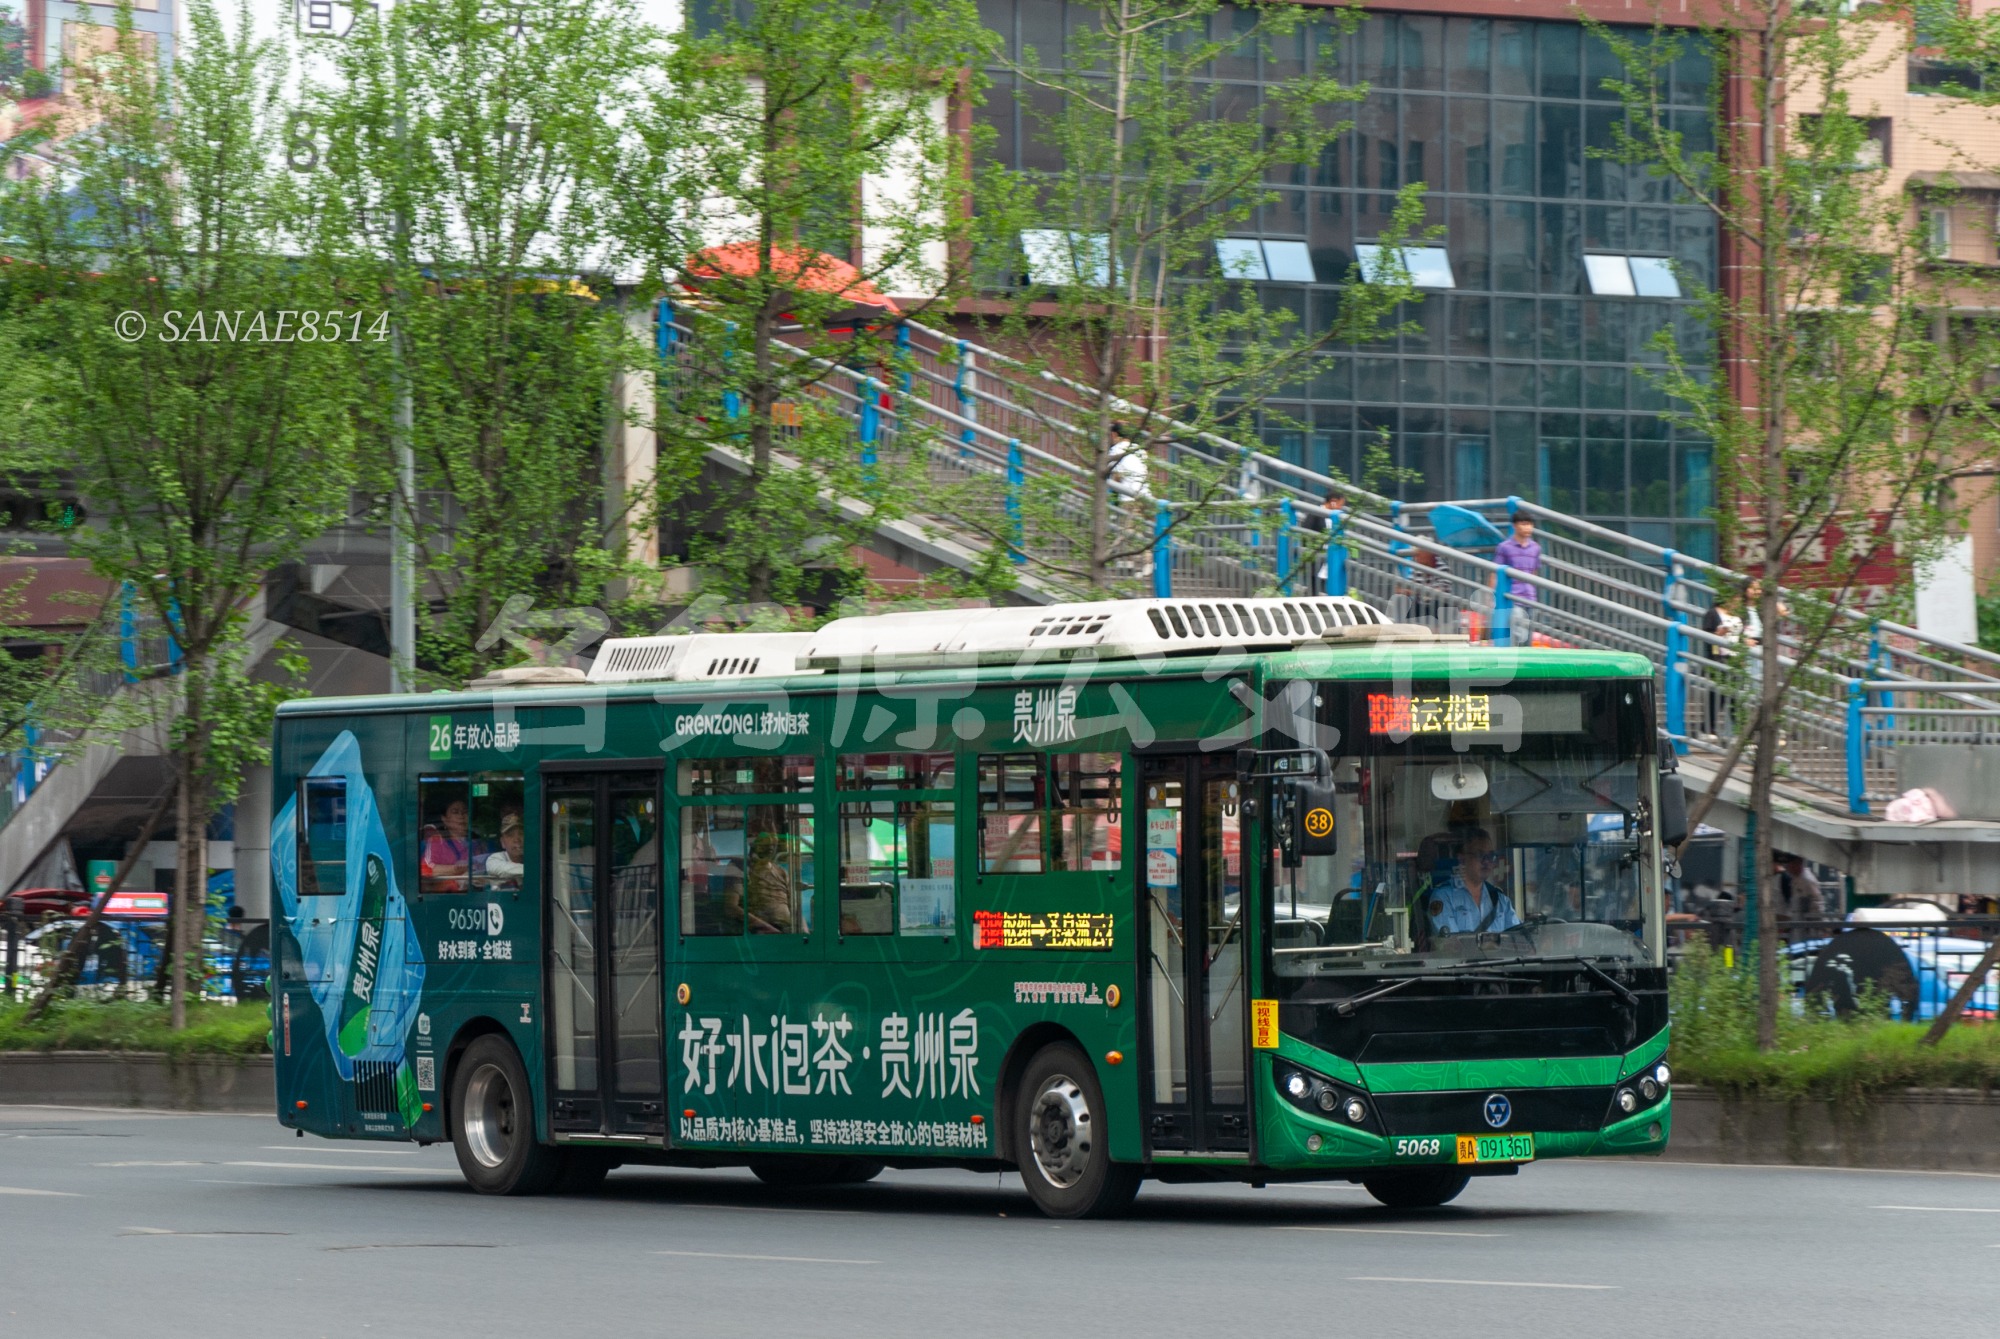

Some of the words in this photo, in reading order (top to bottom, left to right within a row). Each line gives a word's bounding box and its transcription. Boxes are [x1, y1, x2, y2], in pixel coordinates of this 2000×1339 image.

[760, 710, 810, 736] 好水泡茶
[1012, 685, 1077, 744] 贵州泉
[1309, 813, 1328, 830] 38
[448, 908, 487, 930] 96591
[352, 920, 380, 1004] 贵州泉
[438, 940, 512, 961] 好水到家·全城送
[1257, 1007, 1271, 1047] 视线盲区
[678, 1007, 981, 1100] 好水泡茶·贵州泉
[679, 1116, 988, 1149] 以品质为核心基准点，坚持选择安全放心的包装材料
[1396, 1138, 1441, 1156] 5068
